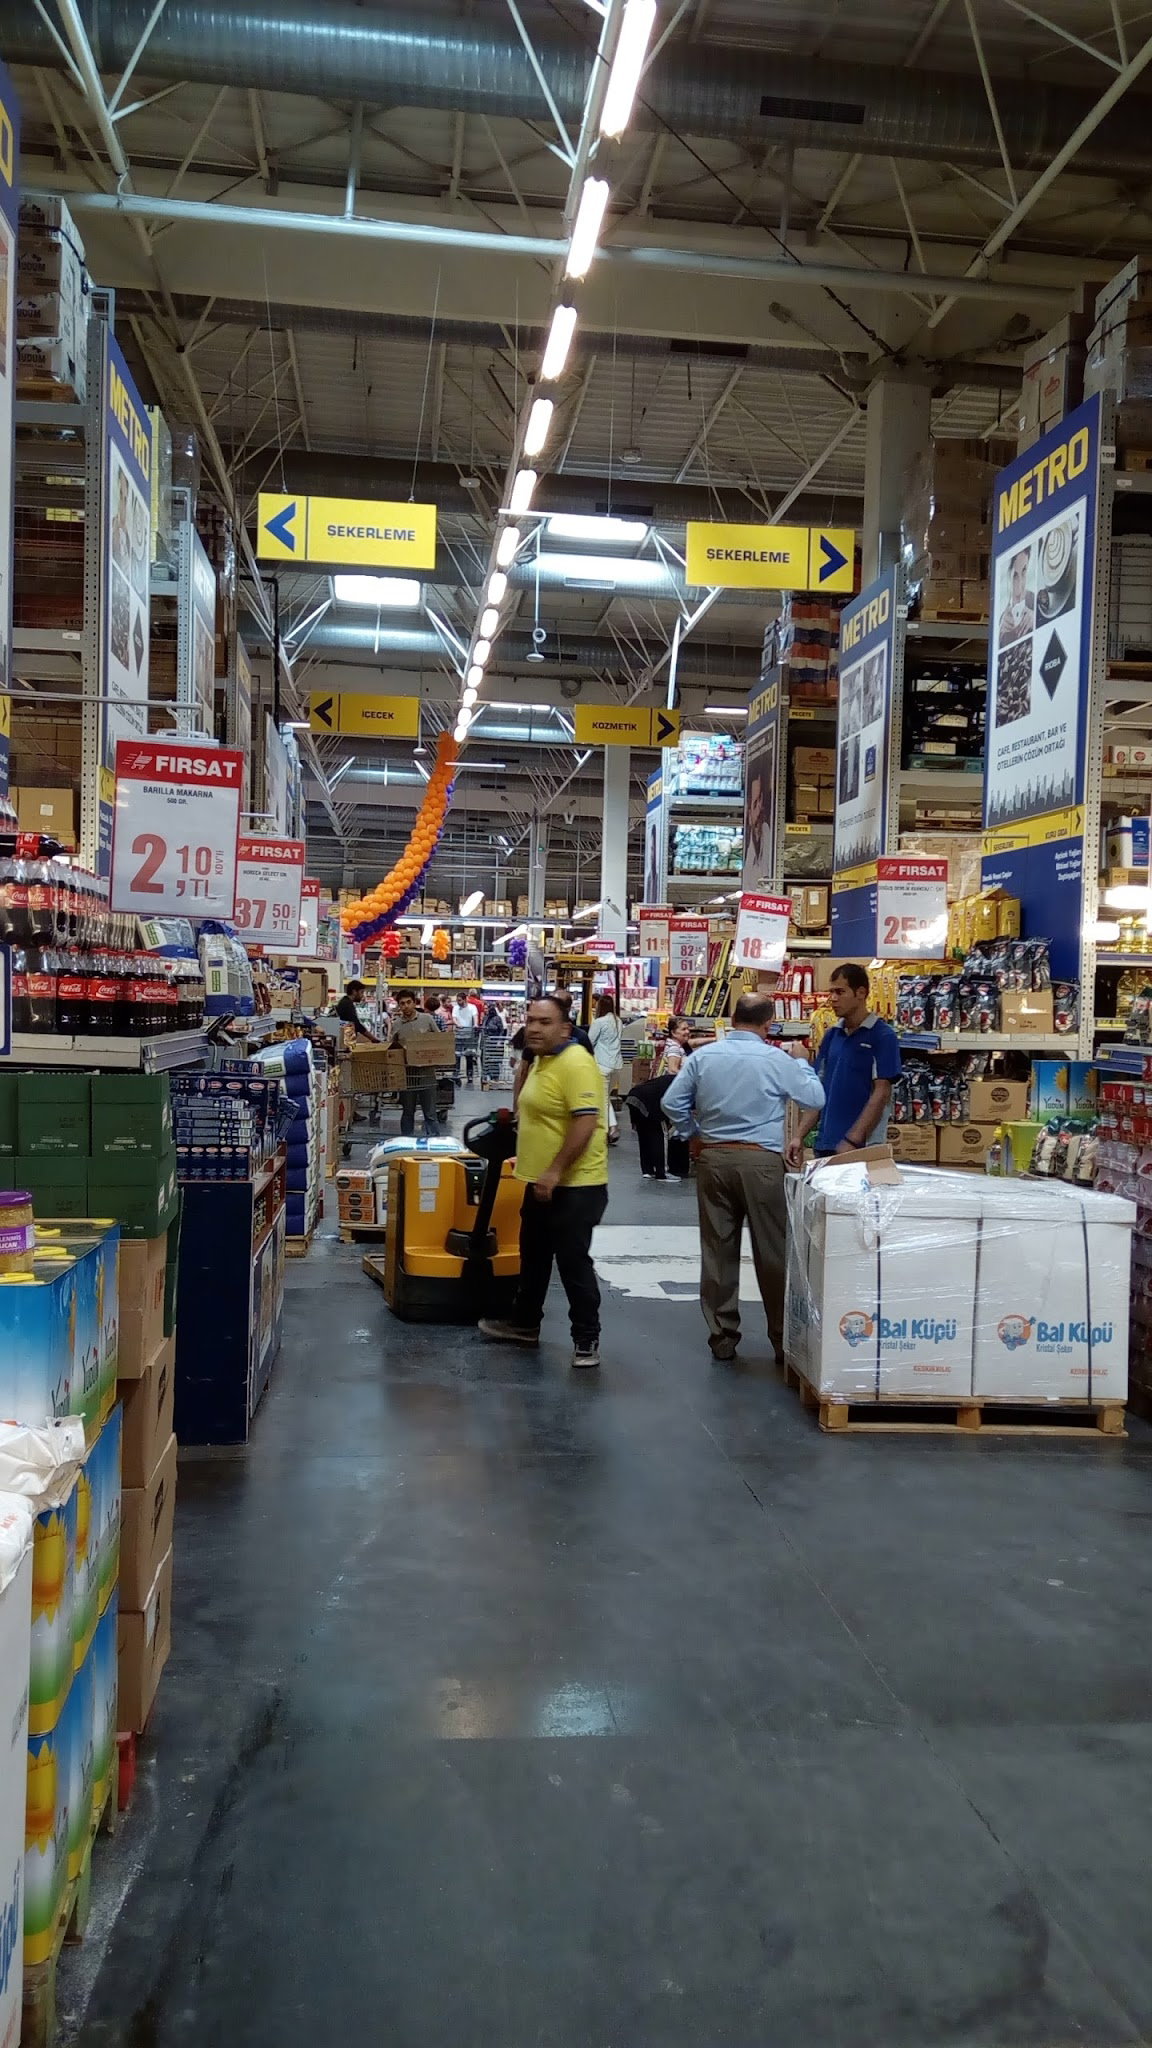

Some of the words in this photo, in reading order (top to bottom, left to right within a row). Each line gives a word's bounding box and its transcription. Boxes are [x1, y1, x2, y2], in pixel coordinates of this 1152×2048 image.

[110, 360, 150, 482] METRO
[998, 426, 1089, 534] METRO
[842, 588, 890, 653] METRO
[155, 755, 237, 778] FIRSAT
[143, 786, 175, 796] BARILLA
[176, 788, 213, 798] MAKARNA
[252, 845, 301, 859] FIRSAT
[899, 866, 944, 876] FIRSAT
[272, 903, 290, 919] 50
[755, 900, 789, 912] FIRSAT
[646, 937, 658, 951] 11
[681, 944, 694, 957] 82
[741, 937, 762, 959] 18
[681, 959, 693, 971] 61
[879, 1318, 907, 1340] Bal
[912, 1318, 957, 1345] Küpü
[1037, 1321, 1064, 1343] Bal
